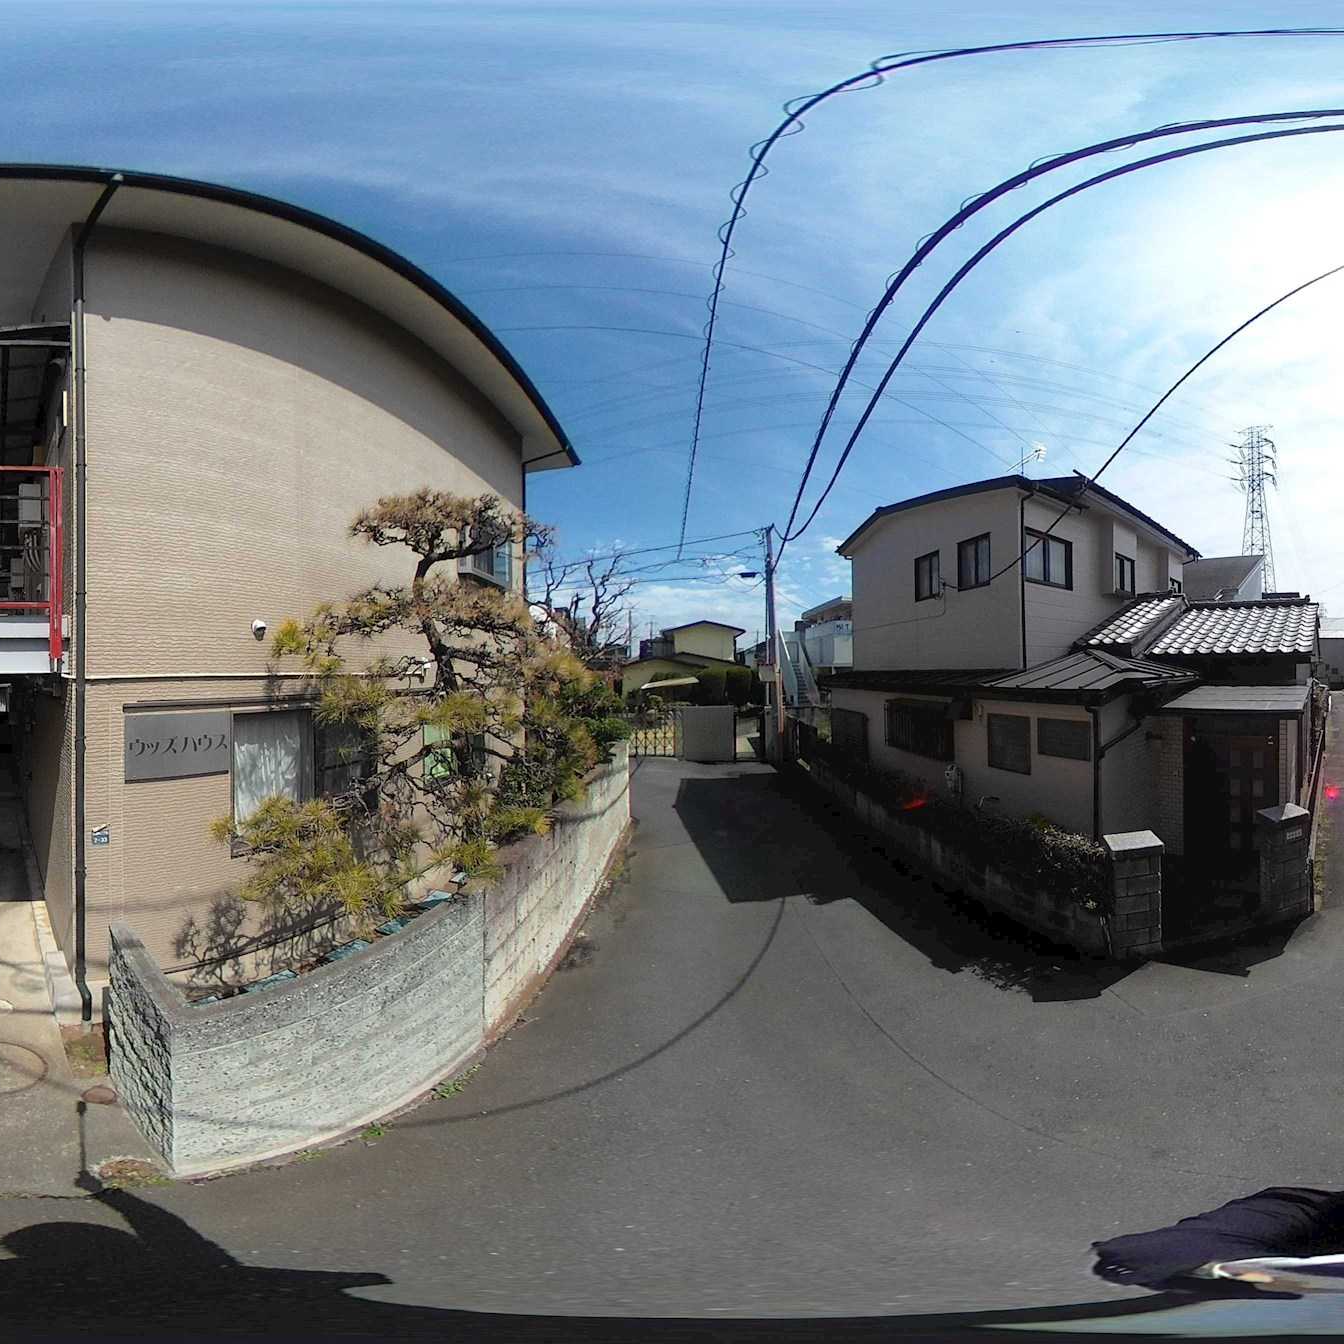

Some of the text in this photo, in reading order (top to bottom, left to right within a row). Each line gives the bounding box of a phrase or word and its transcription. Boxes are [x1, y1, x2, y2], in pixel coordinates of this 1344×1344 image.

[129, 734, 227, 757] ウッズハウス
